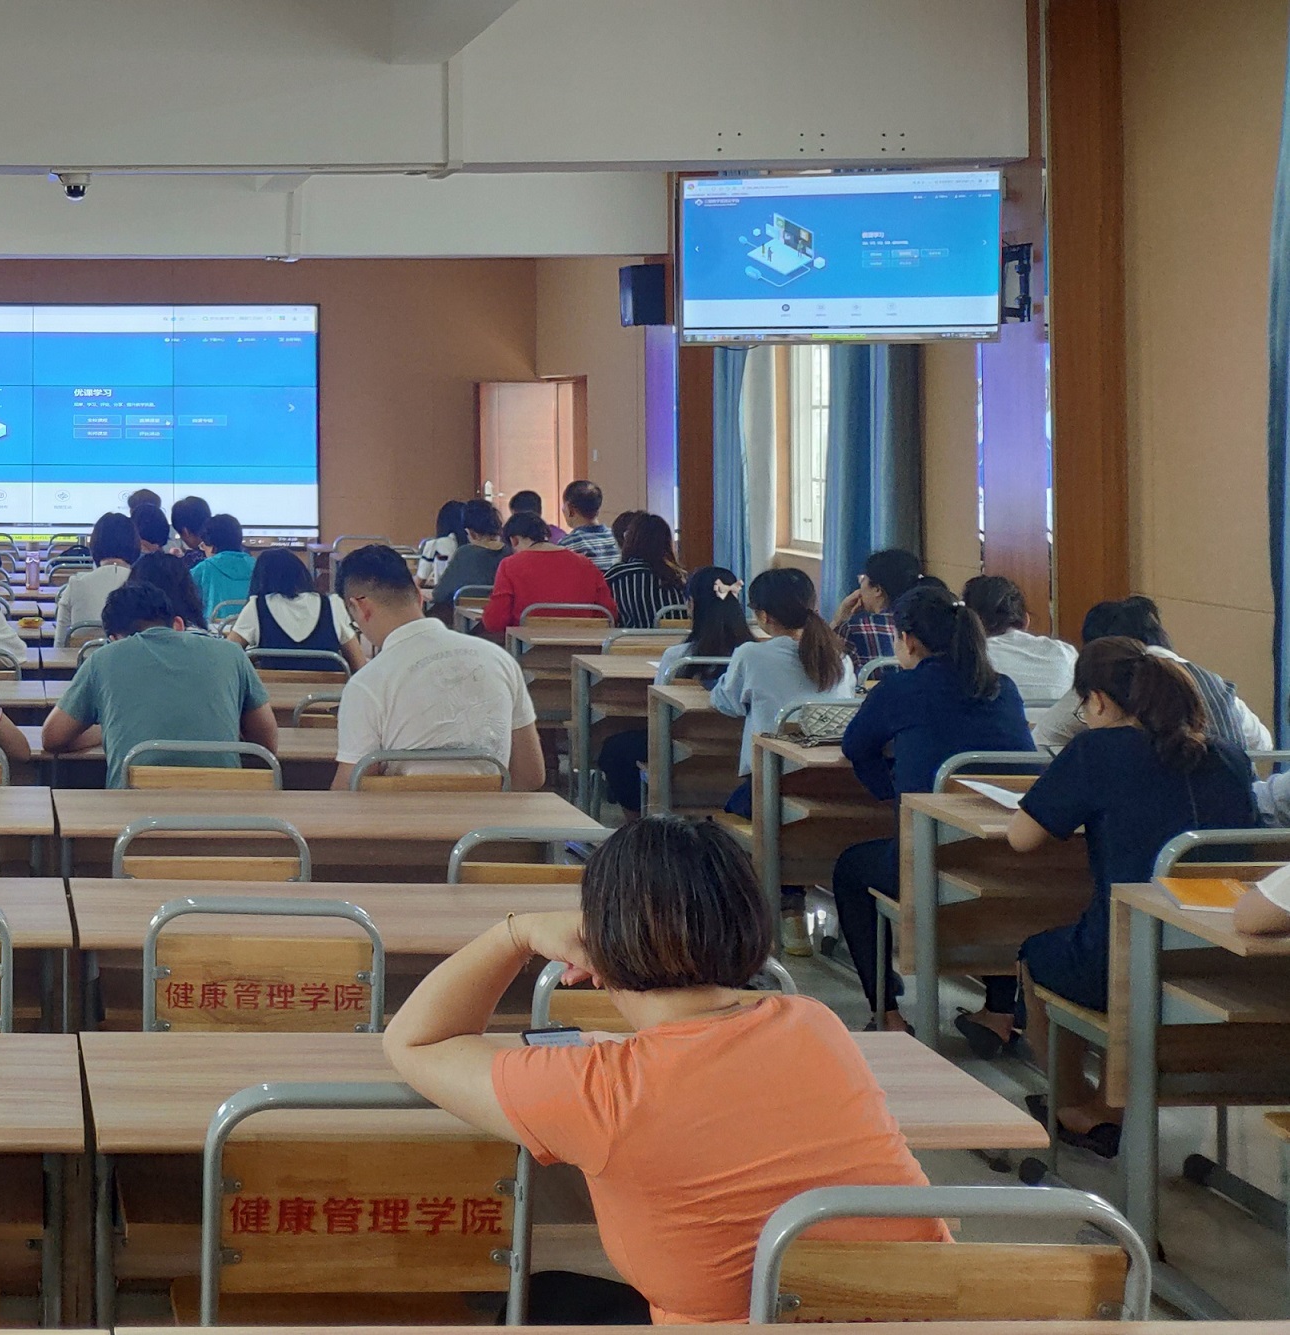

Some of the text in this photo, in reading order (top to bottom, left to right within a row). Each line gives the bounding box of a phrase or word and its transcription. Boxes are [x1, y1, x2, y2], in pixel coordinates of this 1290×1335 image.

[165, 981, 364, 1011] 健康管理学院
[229, 1196, 503, 1235] 健康管理学院
